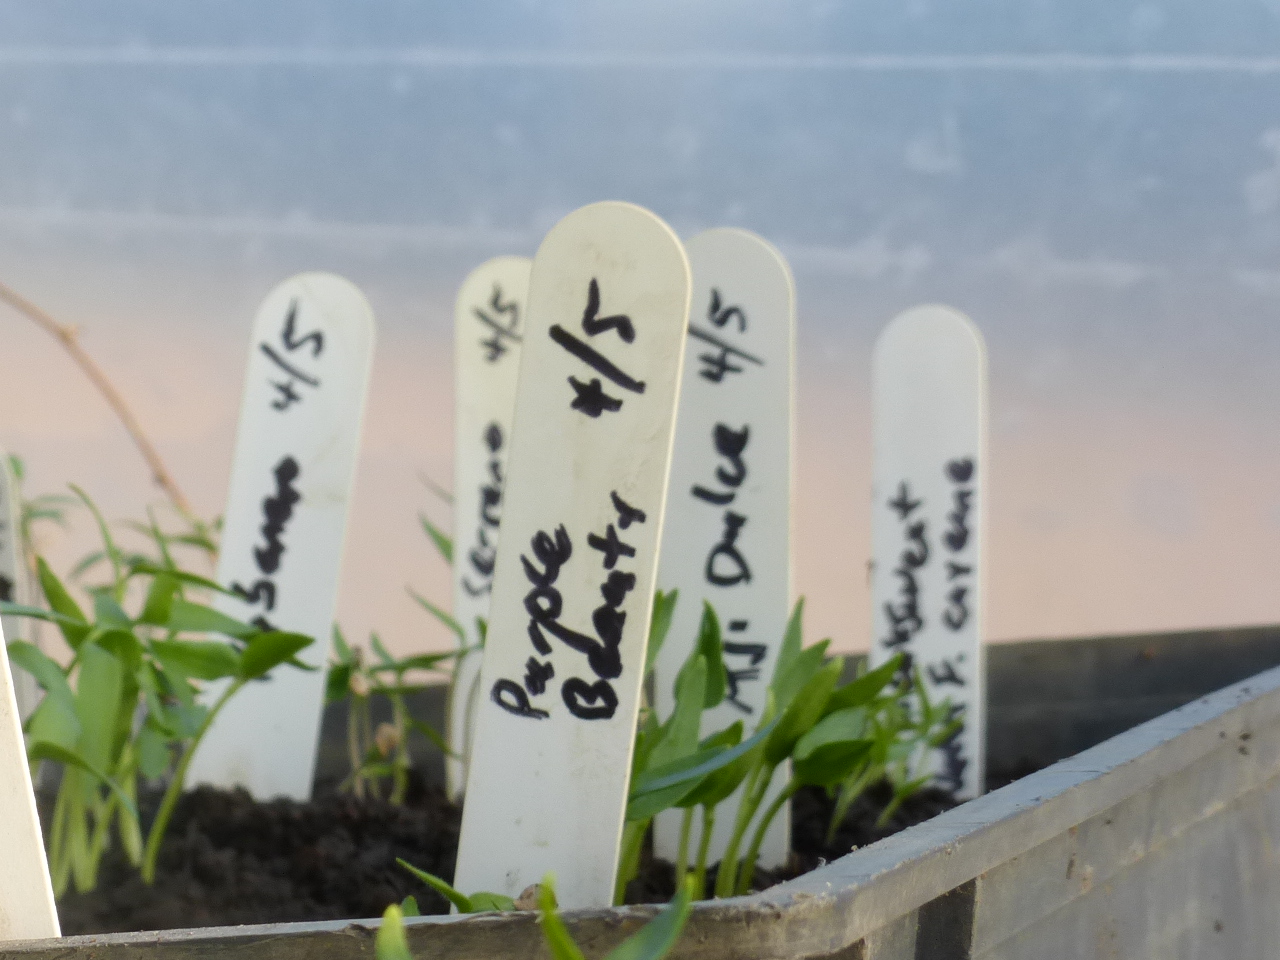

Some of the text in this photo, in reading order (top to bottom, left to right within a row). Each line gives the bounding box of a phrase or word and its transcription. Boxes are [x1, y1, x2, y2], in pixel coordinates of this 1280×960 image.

[258, 297, 324, 413] 4/5
[471, 280, 522, 363] 4/5
[687, 287, 764, 384] 4/5
[489, 277, 646, 719] Purple 4/5
